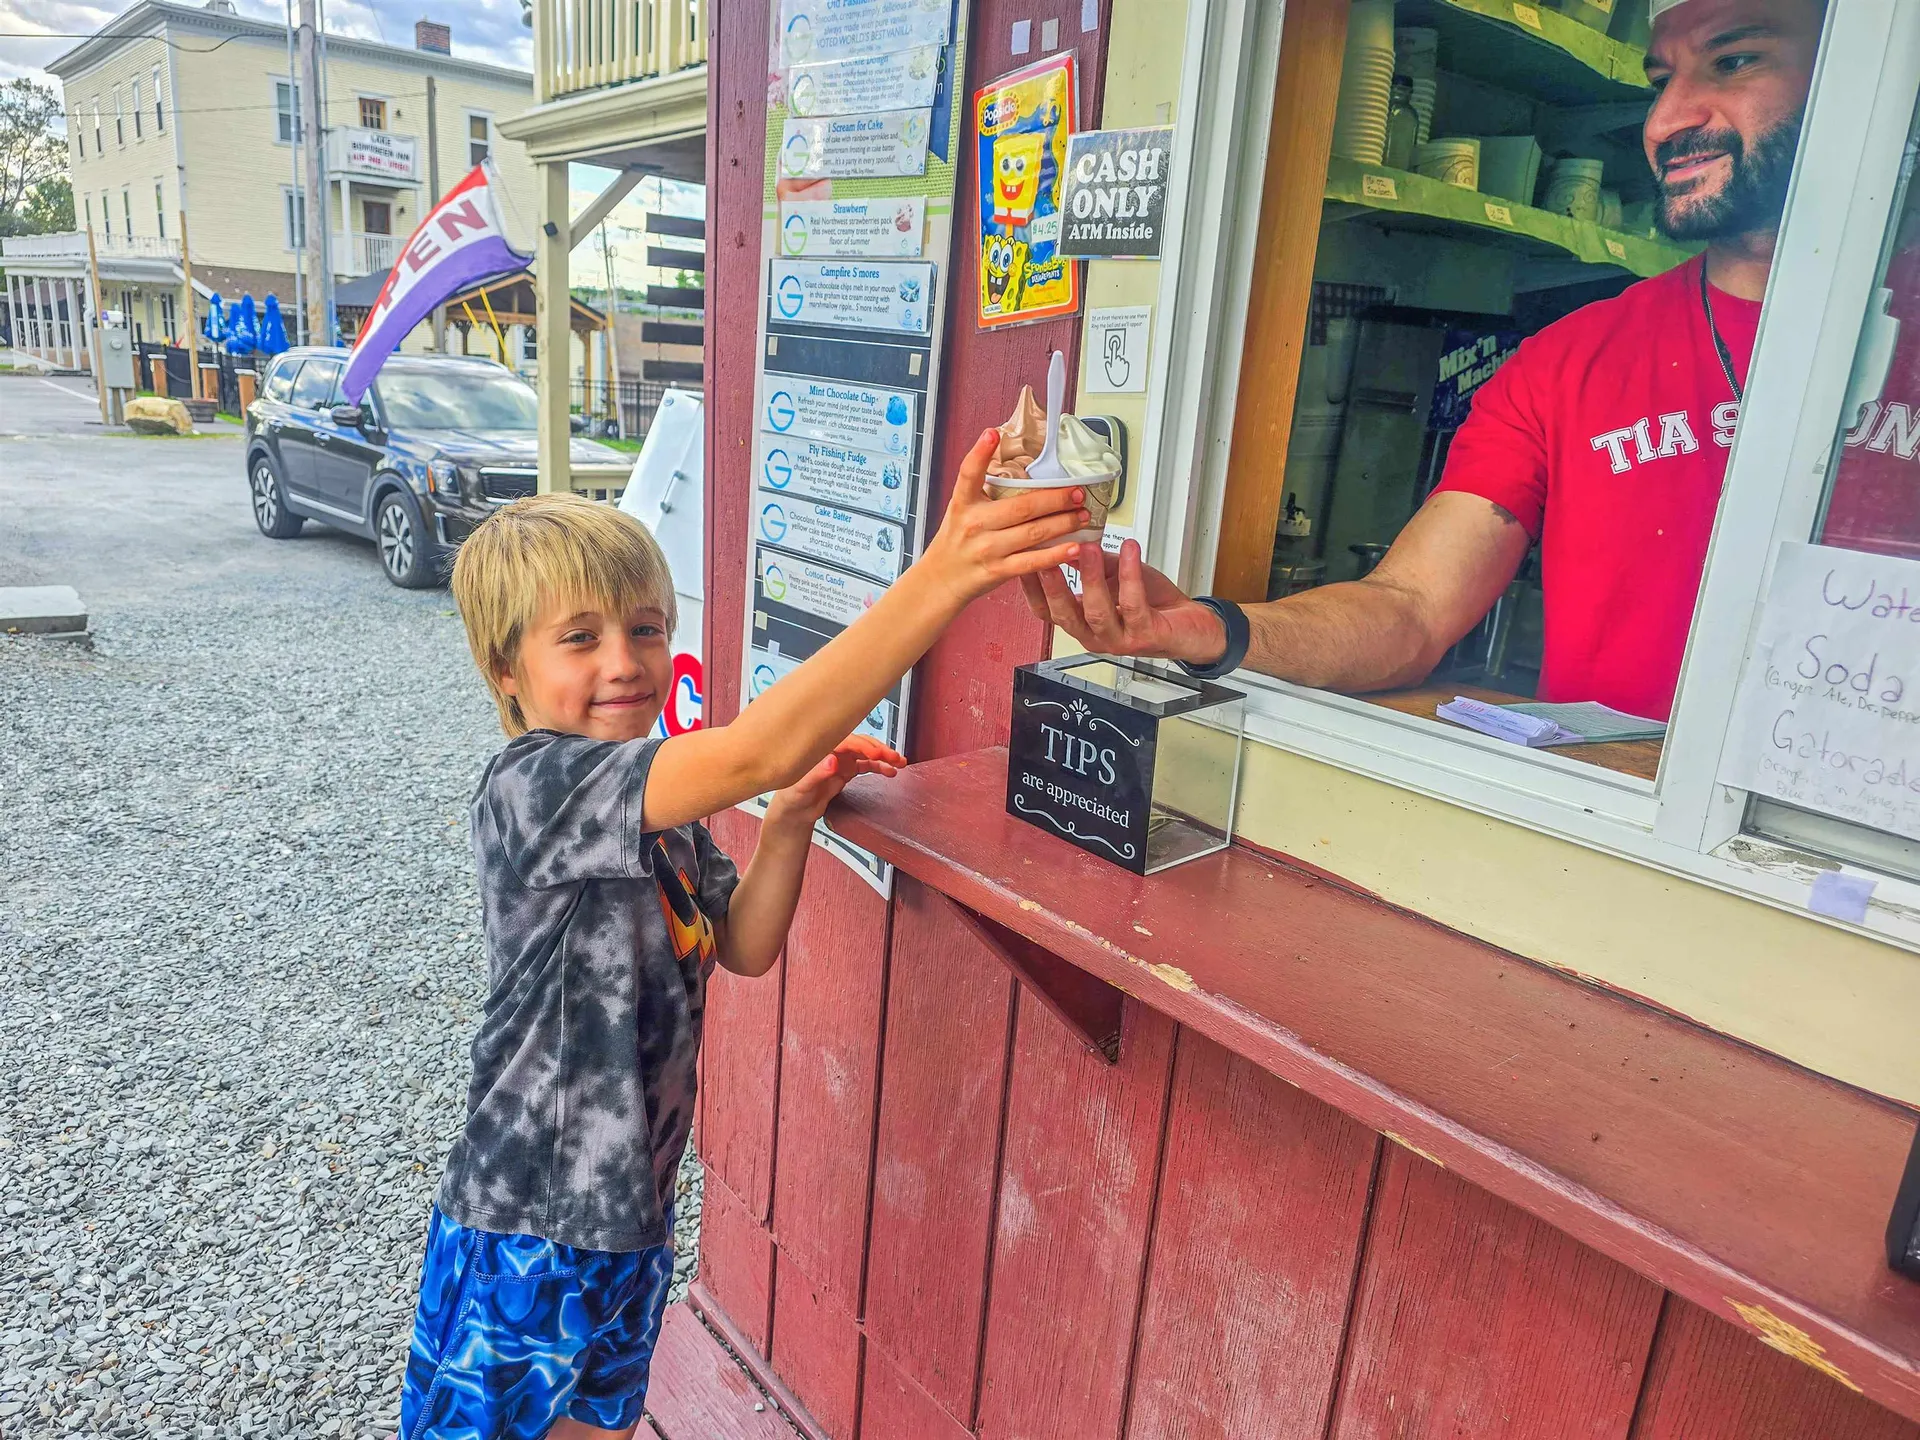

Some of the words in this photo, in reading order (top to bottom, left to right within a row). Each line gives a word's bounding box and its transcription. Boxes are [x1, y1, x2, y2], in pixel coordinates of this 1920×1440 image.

[816, 35, 838, 48] VOTED
[838, 31, 868, 44] WORLD'S
[870, 28, 884, 40] BEST
[885, 24, 912, 37] VANILLA
[983, 100, 1016, 124] Popsicle
[828, 122, 830, 132] I
[832, 121, 855, 132] Scream
[856, 120, 866, 130] for
[867, 119, 883, 130] Cake
[1076, 148, 1161, 183] CASH
[833, 202, 867, 216] Strawberry
[1072, 186, 1158, 219] ONLY
[880, 216, 892, 226] pack
[1033, 220, 1058, 236] $4.25
[1069, 223, 1103, 240] ATM
[1105, 221, 1153, 240] Inside
[821, 228, 836, 236] sweet,
[378, 200, 488, 311] PEN
[820, 265, 850, 280] Campfire
[852, 267, 879, 278] S'mores
[818, 281, 839, 289] chocolate
[840, 282, 851, 292] chips
[823, 292, 840, 301] graham
[863, 294, 878, 303] oozing
[1439, 335, 1497, 382] Mix'n
[809, 385, 824, 396] Mint
[826, 387, 859, 401] Chocolate
[860, 392, 875, 406] Chip
[798, 396, 814, 405] Refresh
[827, 400, 839, 409] mind
[839, 402, 849, 412] (and
[861, 406, 872, 414] taste
[872, 408, 884, 418] buds)
[801, 415, 816, 424] loaded
[837, 421, 859, 431] chocolate
[860, 425, 877, 434] morsels
[1590, 410, 1700, 474] TIA
[808, 444, 819, 457] Fly
[821, 446, 845, 462] Fishing
[847, 451, 866, 466] Fudge
[814, 458, 829, 467] cookie
[846, 464, 855, 473] and
[855, 466, 876, 477] chocolate
[800, 472, 816, 484] flowing
[817, 476, 834, 487] through
[835, 480, 849, 489] vanilla
[814, 504, 830, 517] Cake
[832, 509, 851, 522] Batter
[789, 511, 815, 525] Chocolate
[816, 519, 835, 532] frosting
[836, 525, 854, 535] swirled
[855, 530, 873, 543] through
[791, 521, 807, 534] yellow
[808, 526, 820, 536] cake
[820, 530, 836, 540] batter
[845, 539, 859, 547] cream
[861, 542, 870, 550] and
[809, 536, 833, 548] shortcake
[834, 543, 851, 554] chunks
[1102, 542, 1119, 550] appear
[804, 567, 824, 580] Cotton
[825, 573, 844, 589] Candy
[1823, 569, 1920, 623] Wate
[1797, 634, 1903, 702] Soda
[1040, 723, 1117, 785] TIPS
[1022, 772, 1044, 791] are
[1046, 781, 1130, 829] appreciated
